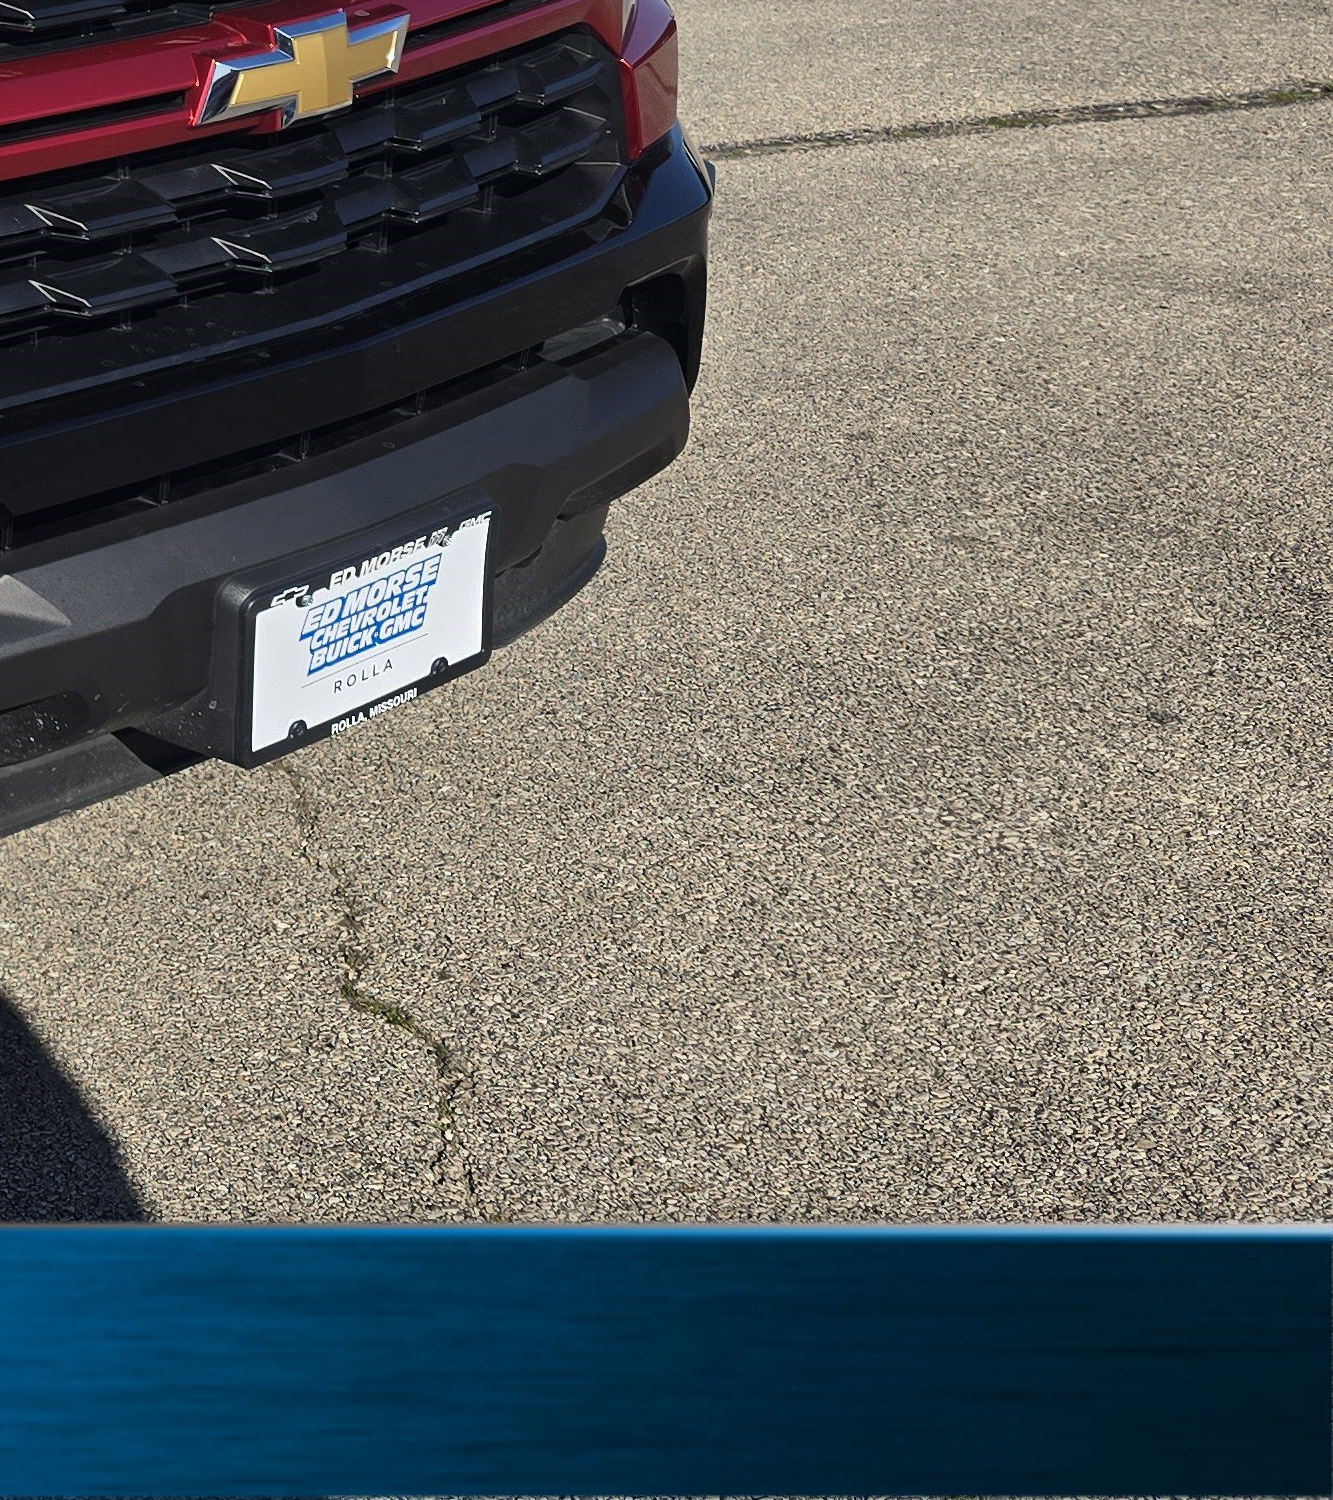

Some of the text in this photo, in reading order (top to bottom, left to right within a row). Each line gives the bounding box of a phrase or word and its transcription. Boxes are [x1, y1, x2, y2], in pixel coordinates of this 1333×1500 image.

[330, 535, 427, 589] ED MORSE
[300, 553, 442, 639] ED MORSE
[310, 586, 429, 650] CHEVROLET
[333, 659, 393, 694] ROLLA
[330, 687, 418, 735] ROLLA, MISSOURI
